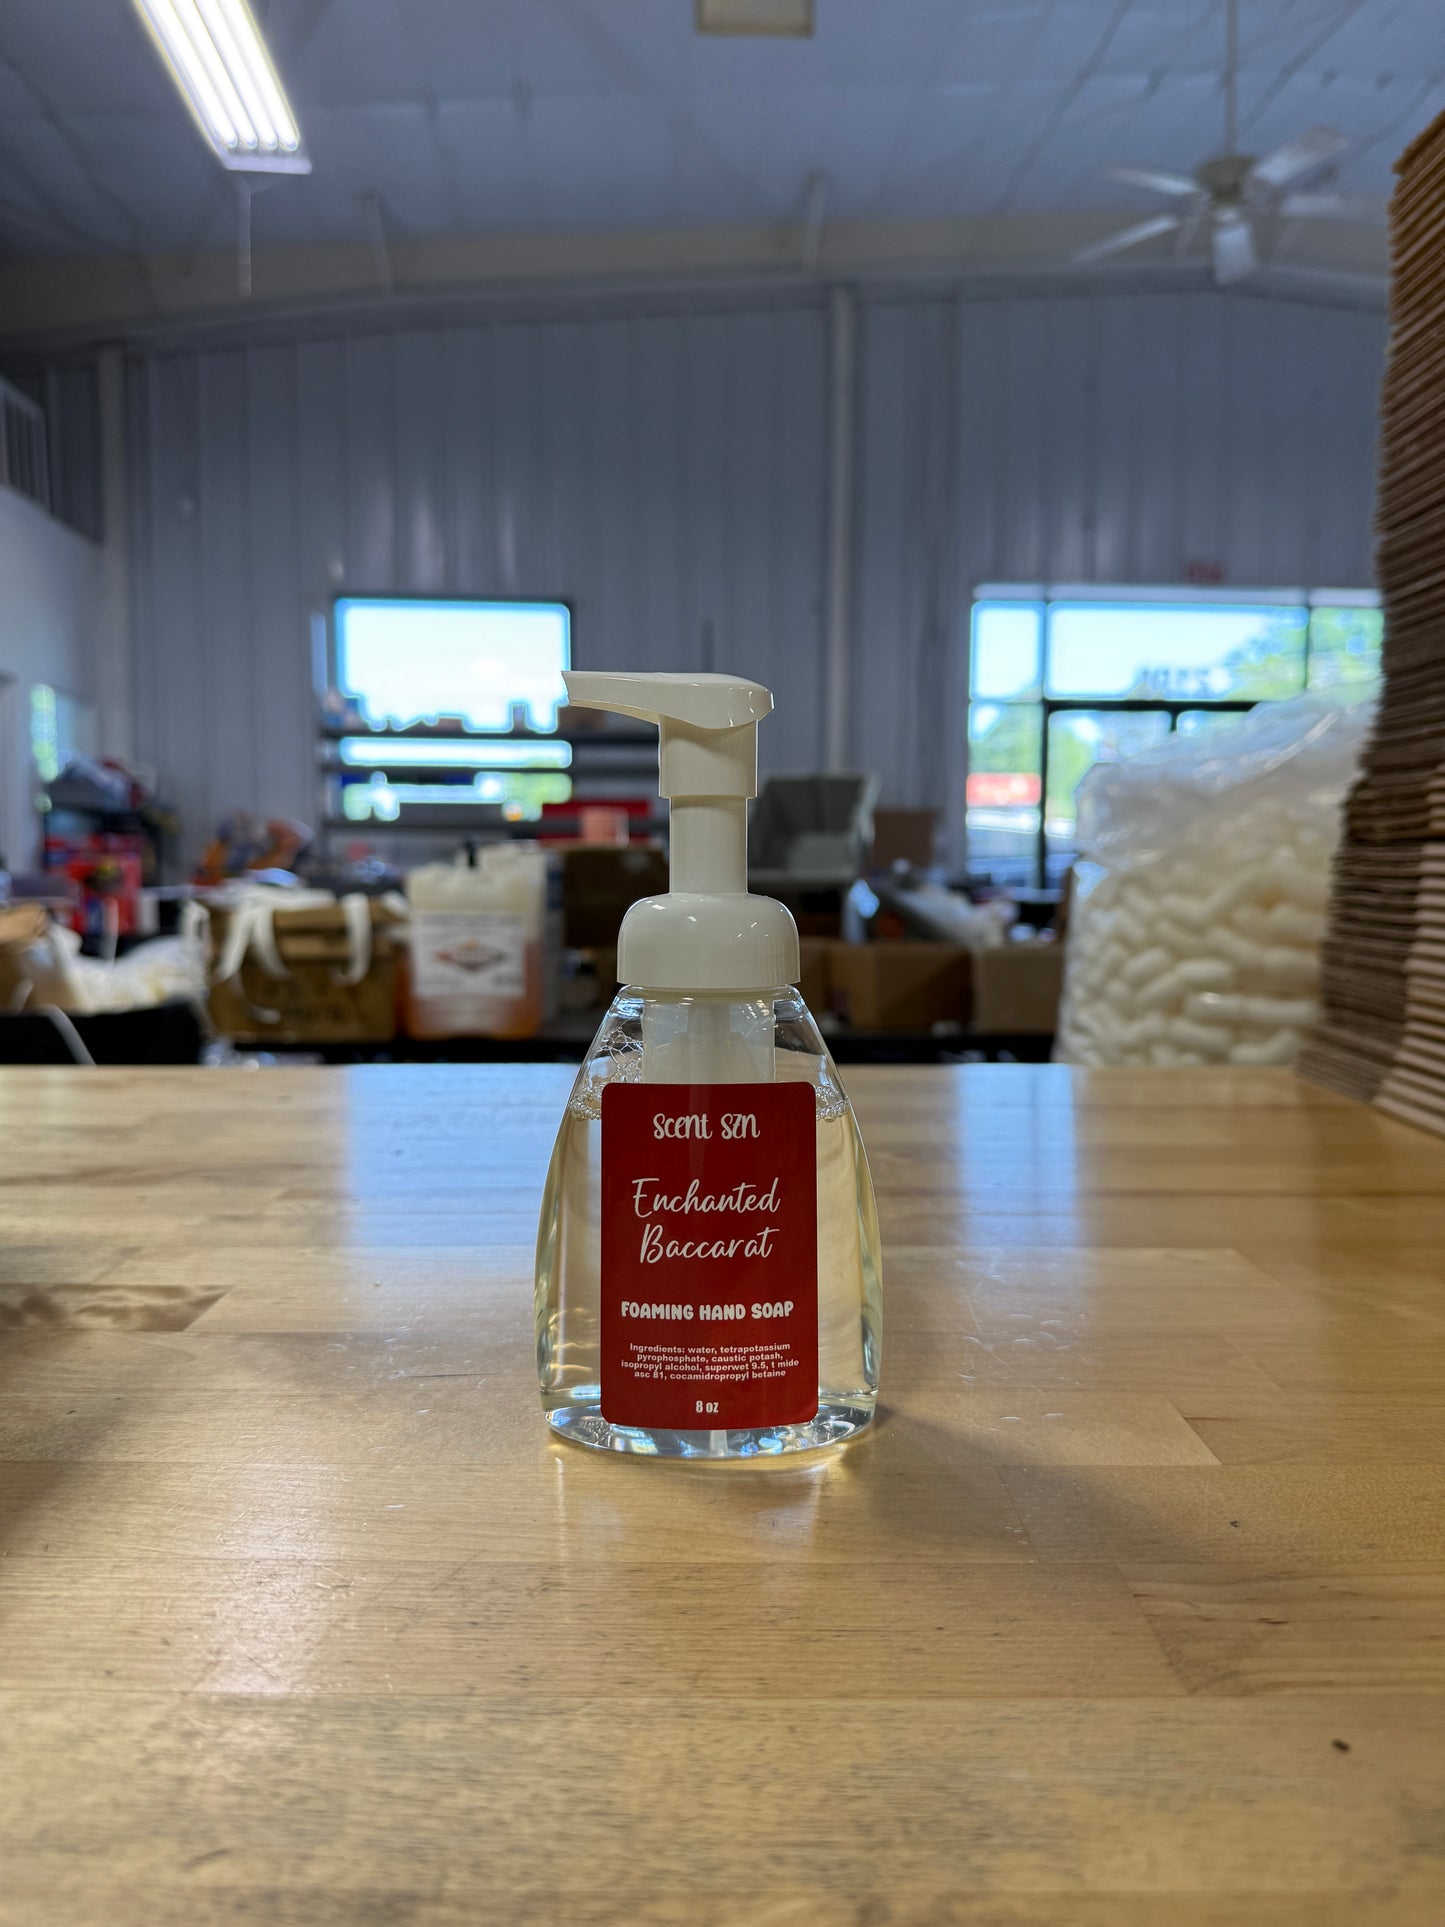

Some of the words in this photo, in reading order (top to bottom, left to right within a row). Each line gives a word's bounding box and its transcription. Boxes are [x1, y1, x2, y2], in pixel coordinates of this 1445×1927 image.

[631, 1177, 781, 1218] Enchanted
[640, 1222, 781, 1264] Baccarat
[621, 1301, 695, 1321] FOAMING
[699, 1303, 747, 1321] HAND
[751, 1301, 794, 1319] SOAP
[629, 1343, 685, 1354] Ingredients:
[688, 1345, 718, 1355] water,
[720, 1343, 791, 1356] tetrapotassium
[637, 1353, 709, 1364] pyrophosphate,
[711, 1353, 747, 1363] caustic
[749, 1352, 784, 1363] potash,
[621, 1360, 663, 1372] isopropyl
[665, 1362, 702, 1373] alcohol,
[704, 1362, 749, 1373] superwet
[751, 1362, 769, 1371] 9.5,
[777, 1359, 800, 1368] mide
[634, 1371, 651, 1379] asc
[670, 1371, 750, 1382] cocamidropropyl
[752, 1369, 787, 1379] betaine
[695, 1400, 704, 1414] 8
